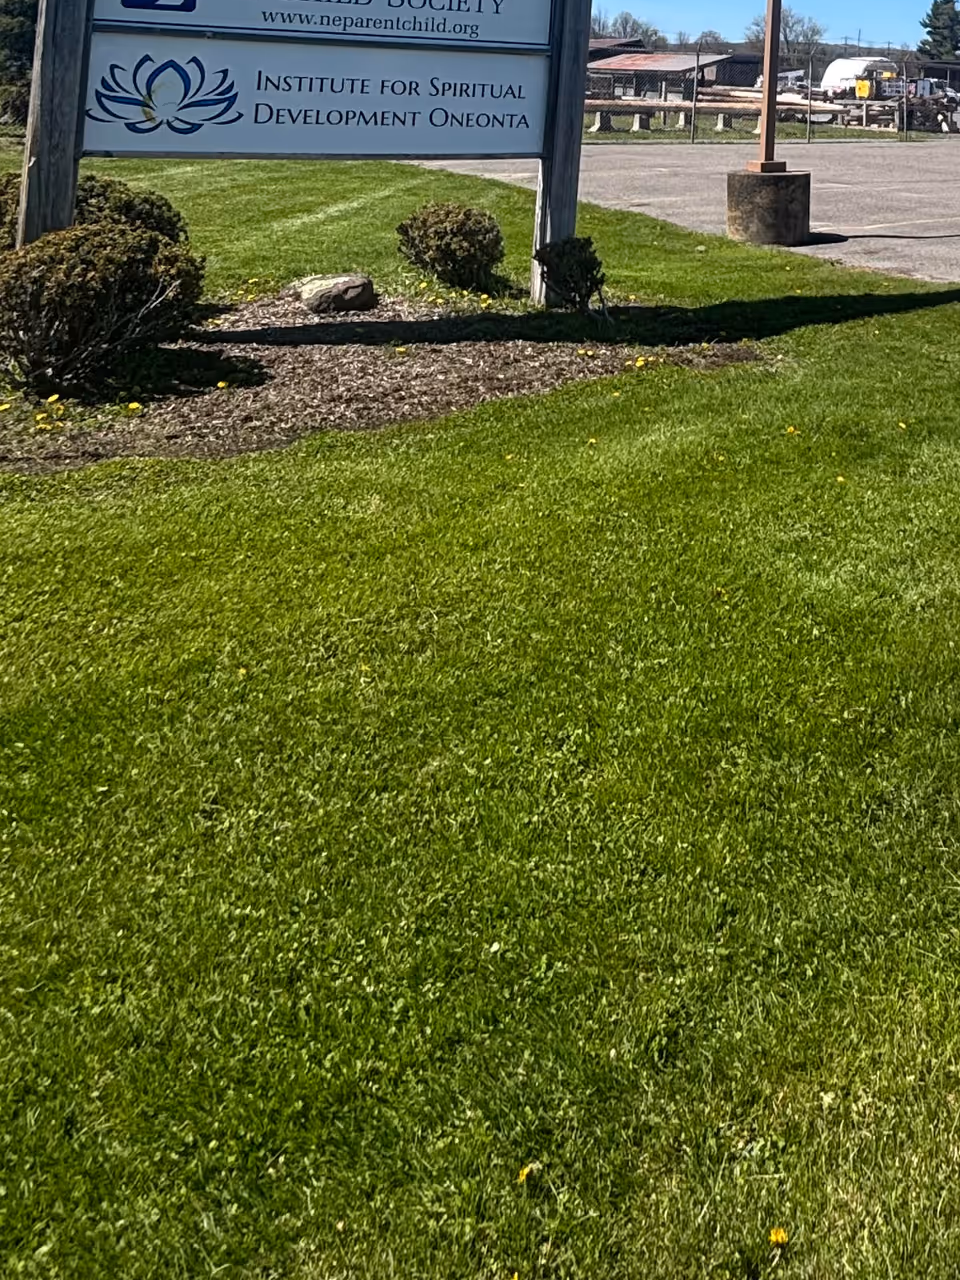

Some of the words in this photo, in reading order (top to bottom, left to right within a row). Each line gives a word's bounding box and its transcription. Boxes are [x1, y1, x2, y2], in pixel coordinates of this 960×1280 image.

[261, 9, 480, 38] www.neparentchild.org
[256, 70, 370, 94] INSTITUTE
[380, 79, 420, 96] FOR
[429, 77, 526, 99] SPIRITUAL
[253, 102, 421, 127] DEVELOPMENT
[429, 107, 530, 129] ONEONTA
